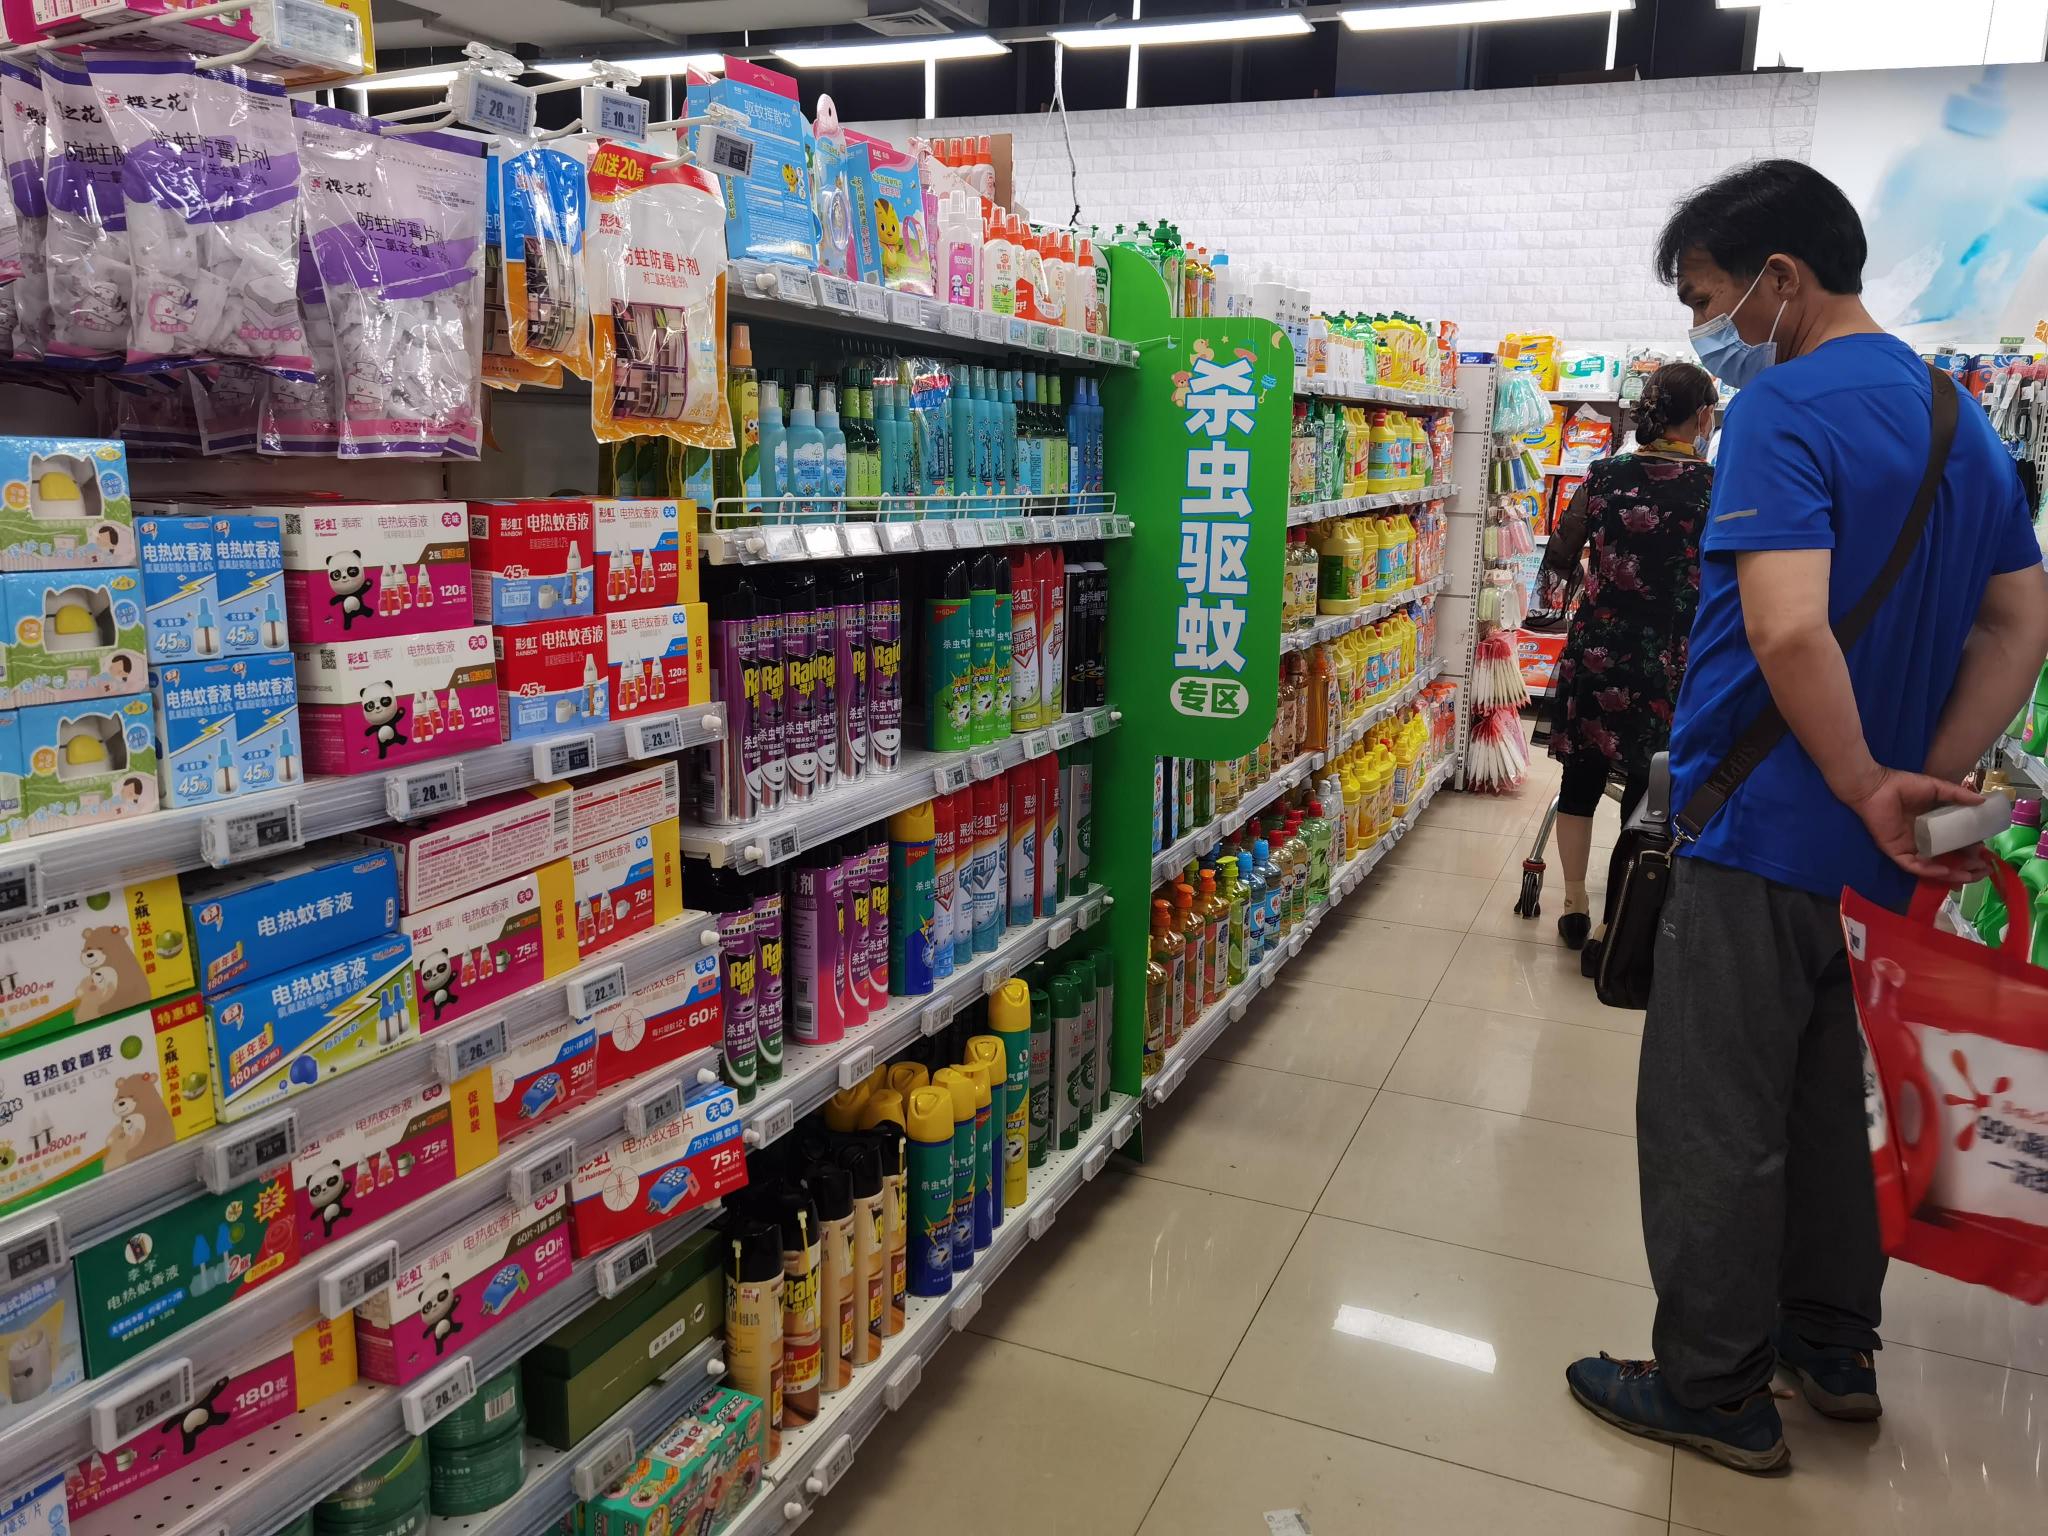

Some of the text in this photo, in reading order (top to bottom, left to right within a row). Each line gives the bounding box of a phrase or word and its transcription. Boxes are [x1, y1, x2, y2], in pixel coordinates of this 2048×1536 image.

[124, 93, 188, 112] 樱之花
[592, 152, 644, 182] 加送20克
[325, 178, 371, 198] 樱之花
[377, 514, 429, 528] 电热蚊香液
[442, 512, 461, 526] 无味
[527, 512, 589, 533] 电热蚊香液
[599, 507, 616, 518] 彩虹
[620, 506, 659, 518] 电热蚊香液
[1174, 358, 1256, 673] 杀虫驱蚊
[314, 518, 337, 531] 彩虹
[500, 517, 523, 531] 彩虹
[143, 542, 213, 562] 电热蚊香液
[216, 540, 281, 559] 电热蚊香液
[610, 619, 627, 629] 彩虹
[631, 615, 668, 629] 电热蚊香液
[469, 635, 488, 650] 无味
[515, 637, 538, 650] 彩虹
[541, 624, 604, 650] 电热蚊香液
[347, 651, 369, 665] 彩虹
[407, 640, 456, 657] 电热蚊香液
[874, 642, 900, 668] Raid
[167, 684, 232, 709] 电热蚊香液
[233, 677, 295, 700] 电热蚊香液
[1178, 680, 1241, 715] 专区
[594, 842, 631, 865] 电热蚊香液
[517, 888, 533, 904] 无味
[257, 892, 354, 937] 电热蚊香液
[461, 896, 510, 925] 电热蚊香液
[413, 924, 432, 940] 彩虹
[211, 950, 241, 973] 半年装
[695, 956, 716, 974] 无味
[272, 956, 369, 1006] 电热蚊香液
[156, 1001, 199, 1026] 特惠装
[688, 1006, 719, 1028] 60片
[234, 1033, 270, 1063] 半年装
[23, 1043, 114, 1087] 电热蚊香液
[570, 1058, 594, 1080] 30片
[356, 1098, 413, 1132] 电热蚊香液
[468, 1088, 481, 1133] 促销装
[705, 1097, 734, 1123] 无味
[711, 1149, 741, 1171] 75片
[585, 1166, 613, 1183] Rainbow
[464, 1207, 521, 1250] 电热蚊香片
[534, 1235, 564, 1263] 60片
[107, 1264, 180, 1311] 电热蚊香液
[396, 1267, 423, 1292] 彩虹
[237, 1375, 288, 1410] 180夜
